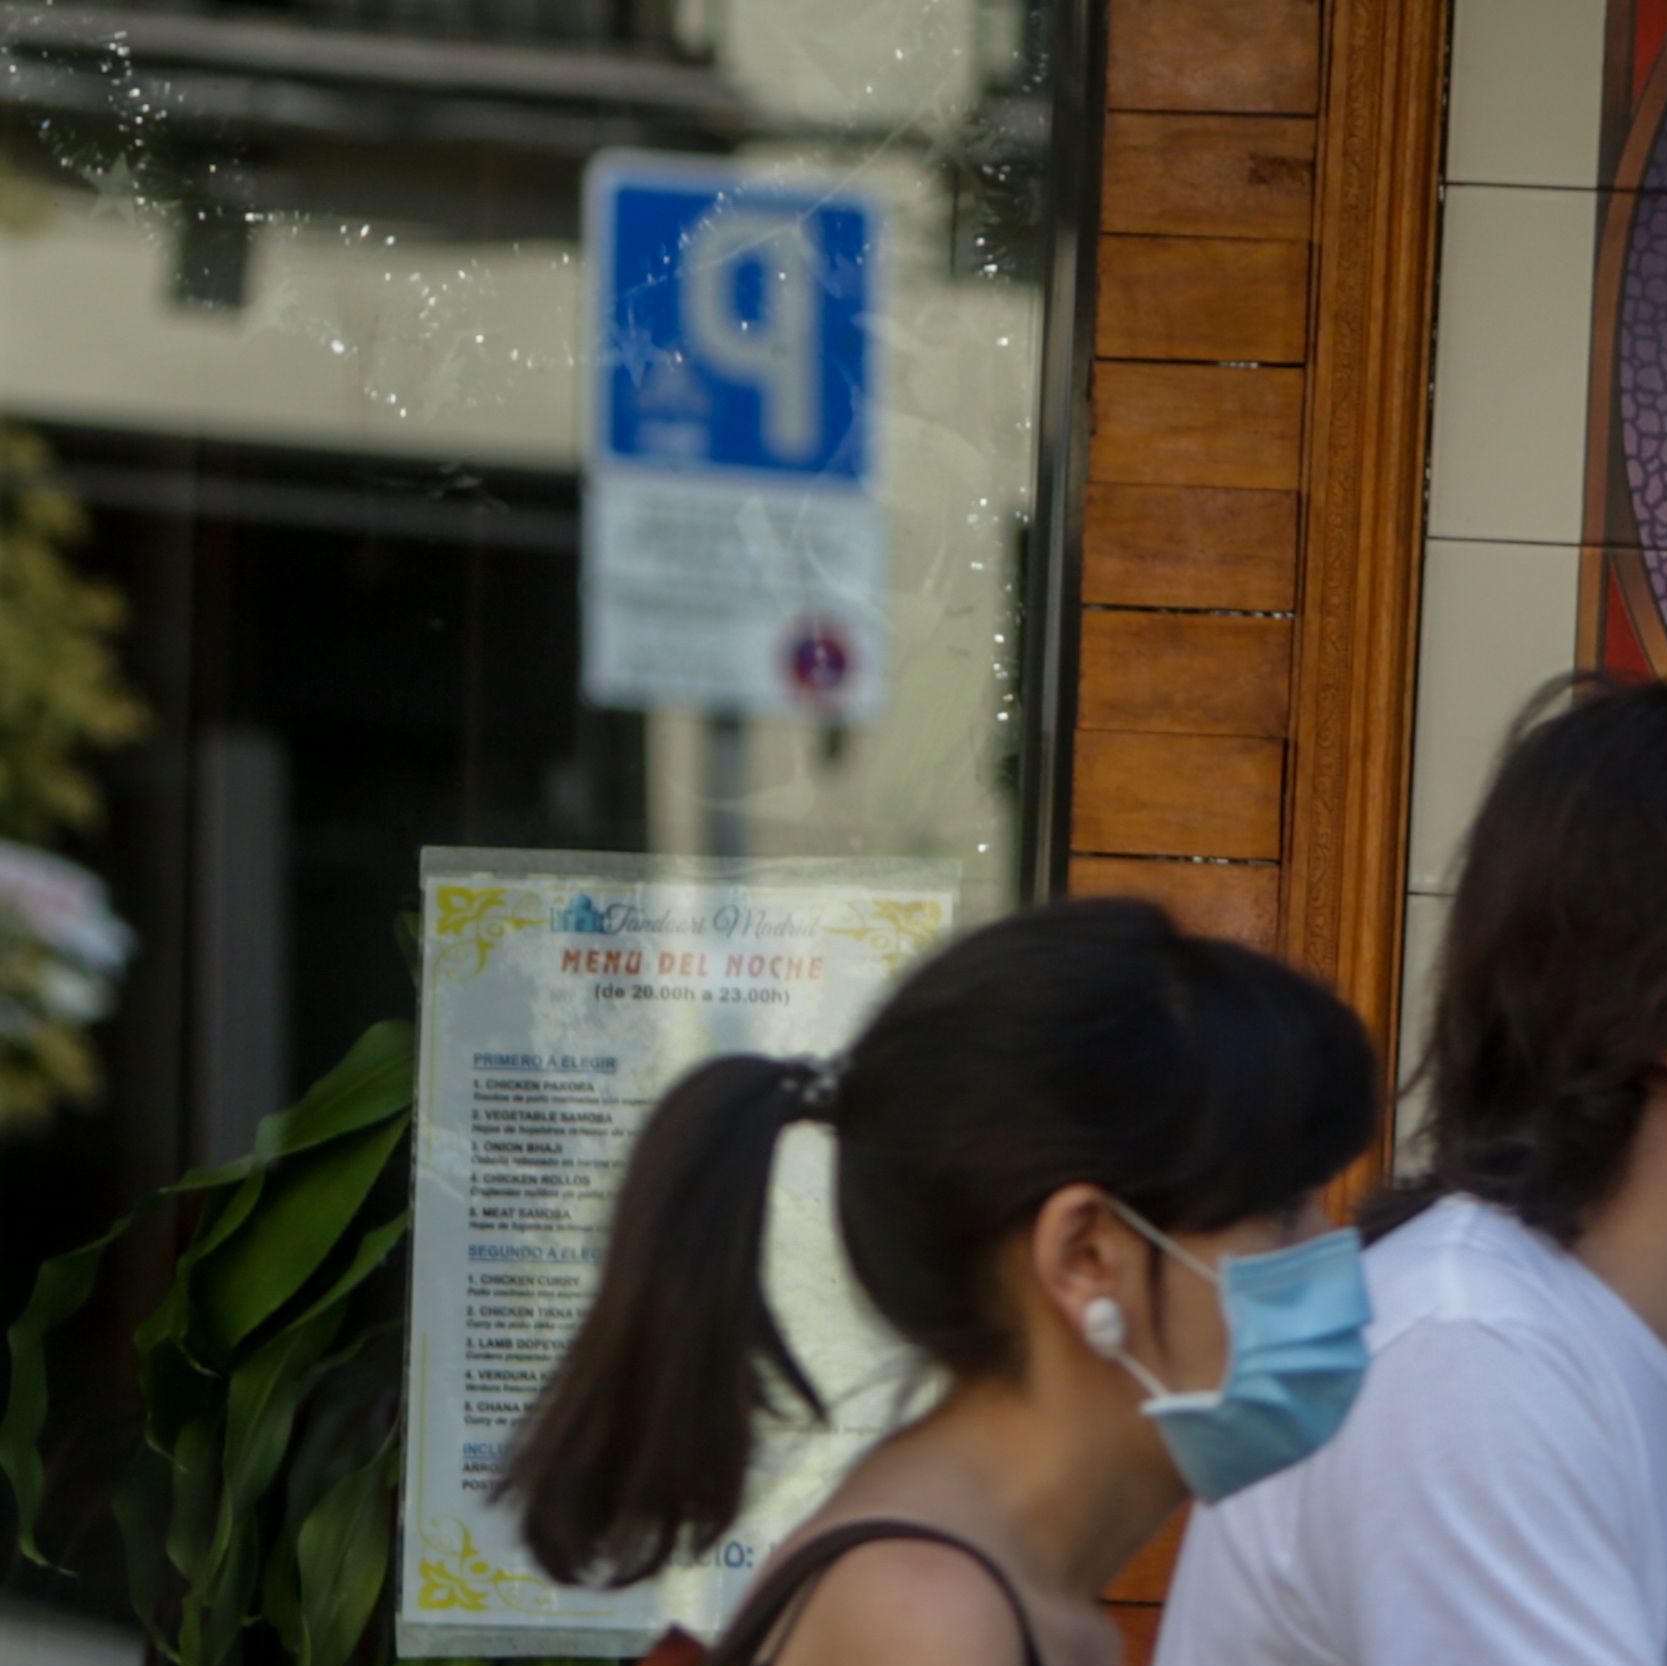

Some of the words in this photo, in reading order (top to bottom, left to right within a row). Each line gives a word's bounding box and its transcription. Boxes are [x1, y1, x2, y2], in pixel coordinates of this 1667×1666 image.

[712, 903, 821, 939] Madrid
[561, 948, 644, 975] MENU
[656, 951, 710, 977] DEL
[725, 953, 825, 981] NOCHE
[593, 984, 626, 1000] (de
[631, 985, 696, 1000] 20.00h
[701, 989, 714, 1000] a
[718, 986, 791, 1005] 23.00h)
[473, 1053, 542, 1068] PRIMERO
[547, 1055, 558, 1068] A
[561, 1056, 617, 1070] ELEGIR
[485, 1079, 540, 1091] CHICKEN
[485, 1110, 556, 1122] VEGETABLE
[560, 1111, 613, 1123] SAMOSA
[483, 1142, 523, 1153] ONION
[526, 1143, 563, 1154] BHAJI
[483, 1174, 538, 1185] CHICKEN
[541, 1175, 590, 1186] ROLLOS
[482, 1207, 515, 1218] MEAT
[518, 1208, 571, 1220] SAMOSA
[468, 1245, 543, 1259] SEGUNDO
[546, 1246, 558, 1259] A
[480, 1274, 535, 1286] CHICKEN
[537, 1275, 580, 1287] CURRY
[479, 1306, 534, 1317] CHICKEN
[478, 1338, 513, 1349] LAMB
[477, 1369, 538, 1381] VERDURA
[476, 1401, 521, 1412] CHANA
